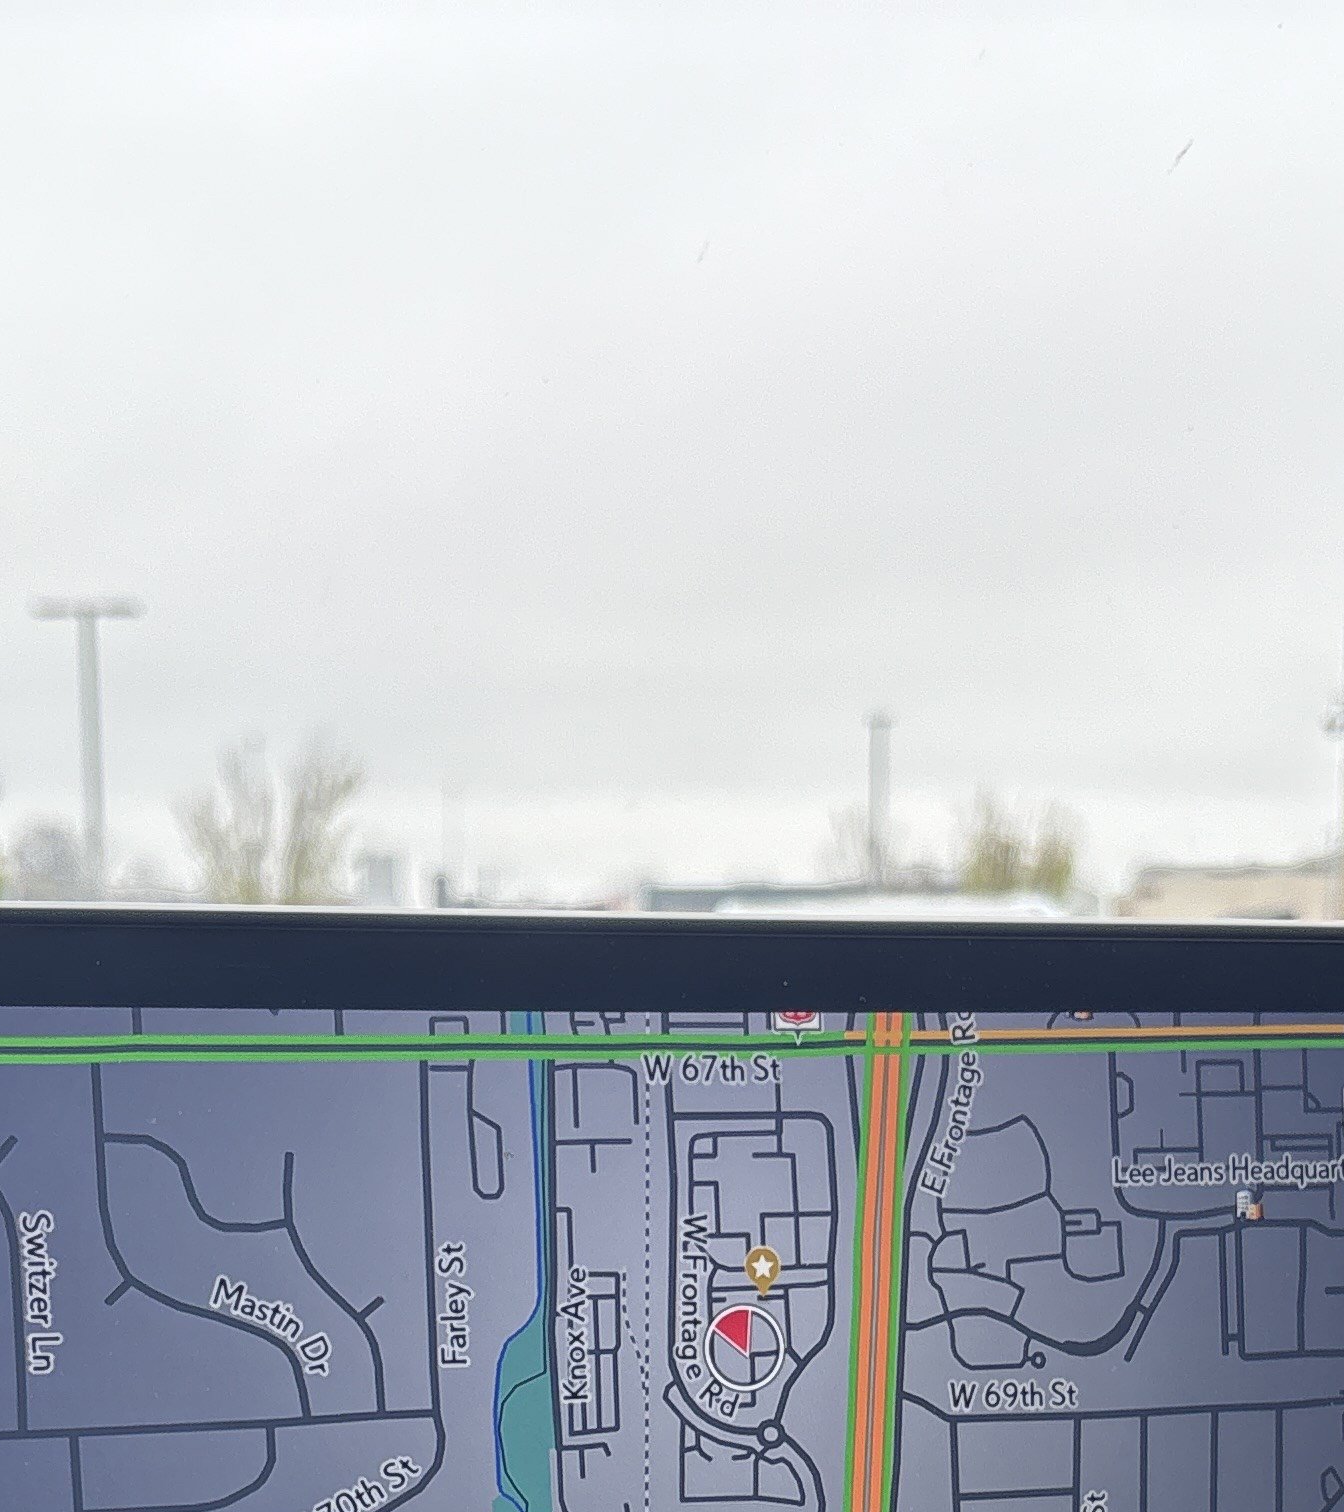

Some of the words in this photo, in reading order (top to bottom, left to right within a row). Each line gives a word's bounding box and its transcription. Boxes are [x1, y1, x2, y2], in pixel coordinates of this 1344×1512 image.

[642, 1054, 672, 1082] W
[682, 1053, 746, 1082] 67th
[753, 1055, 780, 1081] St
[930, 1052, 981, 1168] Frontage
[921, 1170, 946, 1195] E
[1114, 1158, 1154, 1184] Lee
[1162, 1156, 1224, 1185] Jeans
[683, 1215, 707, 1249] W
[22, 1212, 55, 1326] Switzer
[438, 1242, 465, 1275] St
[563, 1266, 588, 1321] Ave
[211, 1277, 302, 1339] Mastin
[300, 1334, 332, 1376] Dr
[441, 1278, 474, 1367] Farley
[676, 1256, 707, 1380] Frontage
[29, 1334, 61, 1372] Ln
[563, 1324, 588, 1403] Knox
[699, 1381, 739, 1418] Rd
[950, 1382, 977, 1409] W
[985, 1380, 1043, 1407] 69th
[1052, 1381, 1077, 1406] St
[382, 1456, 420, 1488] St
